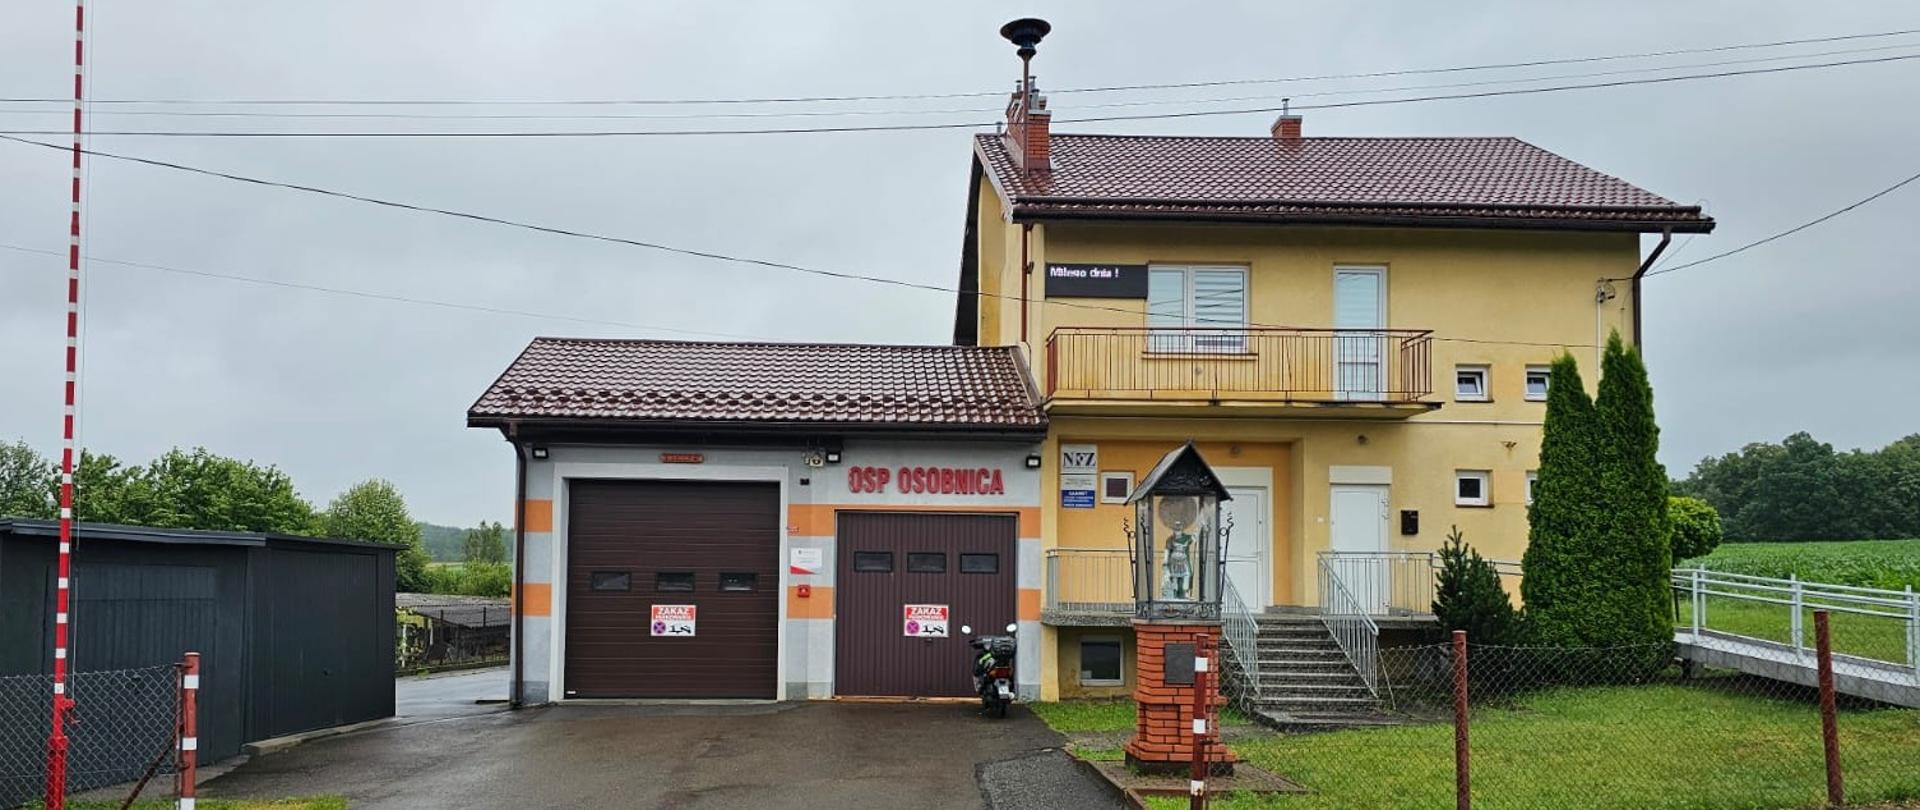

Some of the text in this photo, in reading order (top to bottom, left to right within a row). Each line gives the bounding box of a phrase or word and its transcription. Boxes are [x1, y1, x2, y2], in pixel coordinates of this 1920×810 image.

[1064, 452, 1096, 466] NFZ
[848, 466, 1004, 495] OSP OSOBNICA
[910, 607, 942, 615] ZAKAZ
